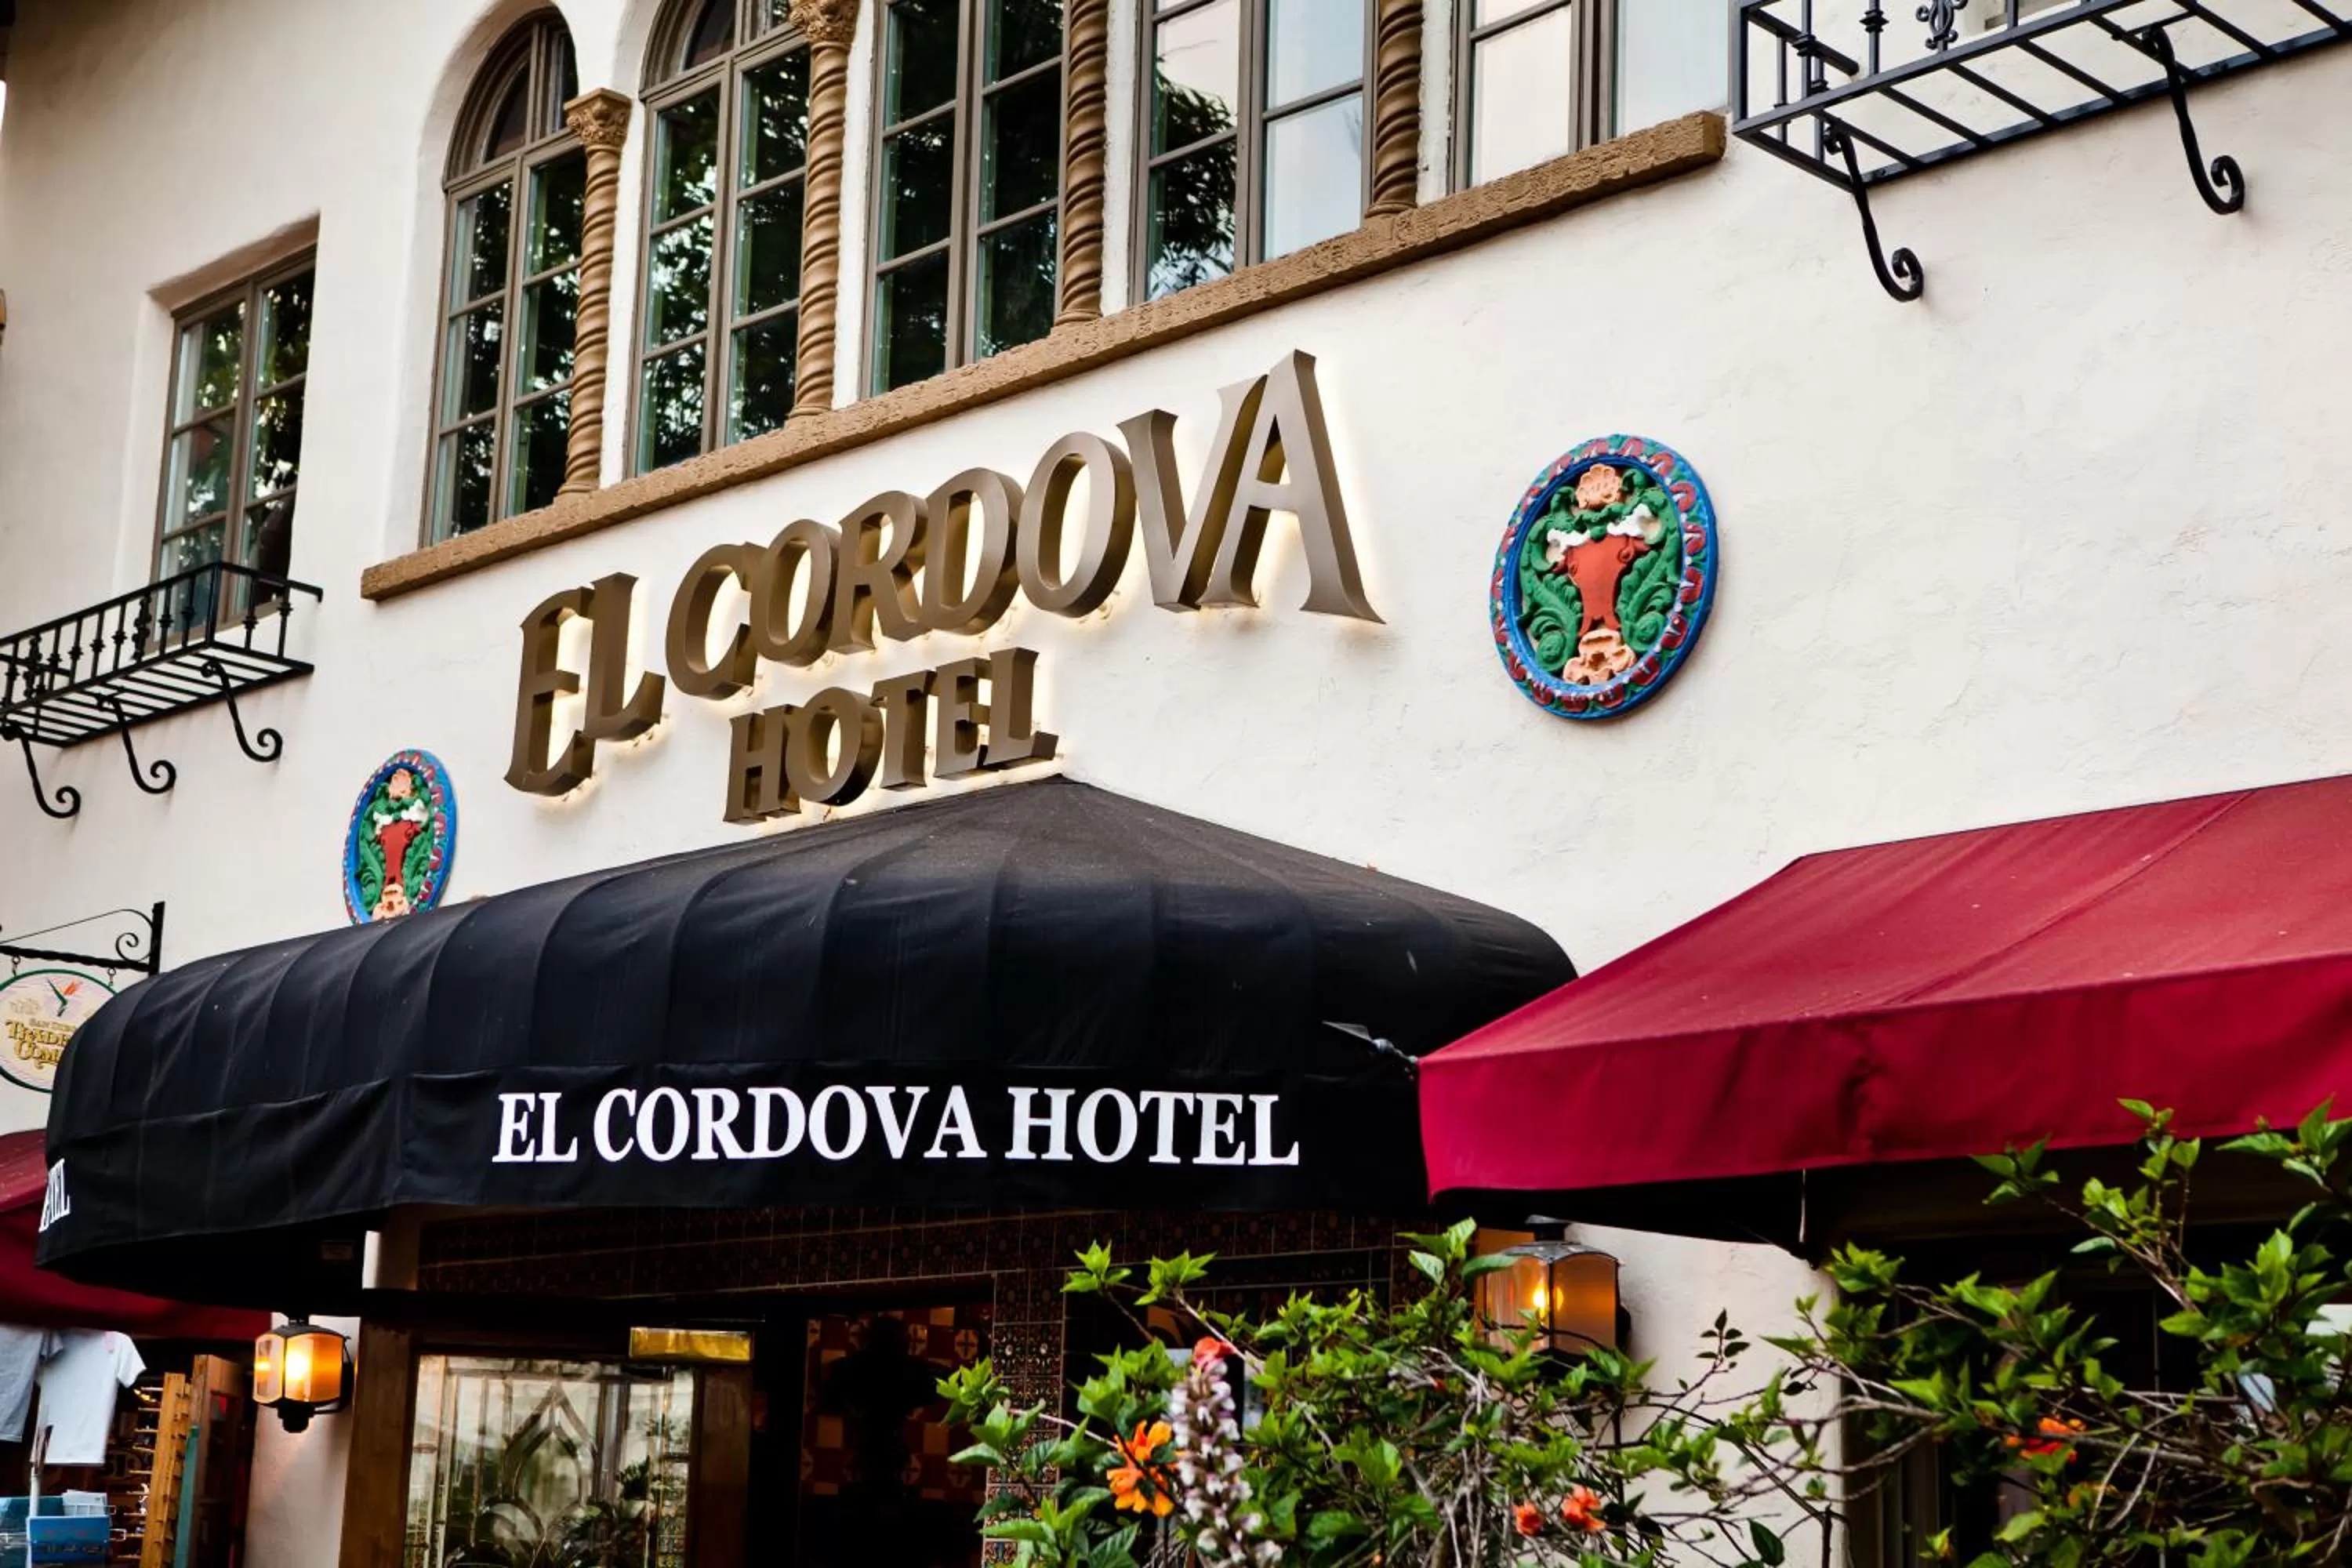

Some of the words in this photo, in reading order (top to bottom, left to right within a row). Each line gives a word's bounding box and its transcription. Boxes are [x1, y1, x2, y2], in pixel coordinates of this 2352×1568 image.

[503, 572, 666, 797] EL
[664, 349, 1386, 700] CORDOVA
[722, 647, 1059, 825] HOTEL
[492, 1093, 578, 1163] EL
[593, 1085, 987, 1162] CORDOVA
[1004, 1087, 1299, 1166] HOTEL
